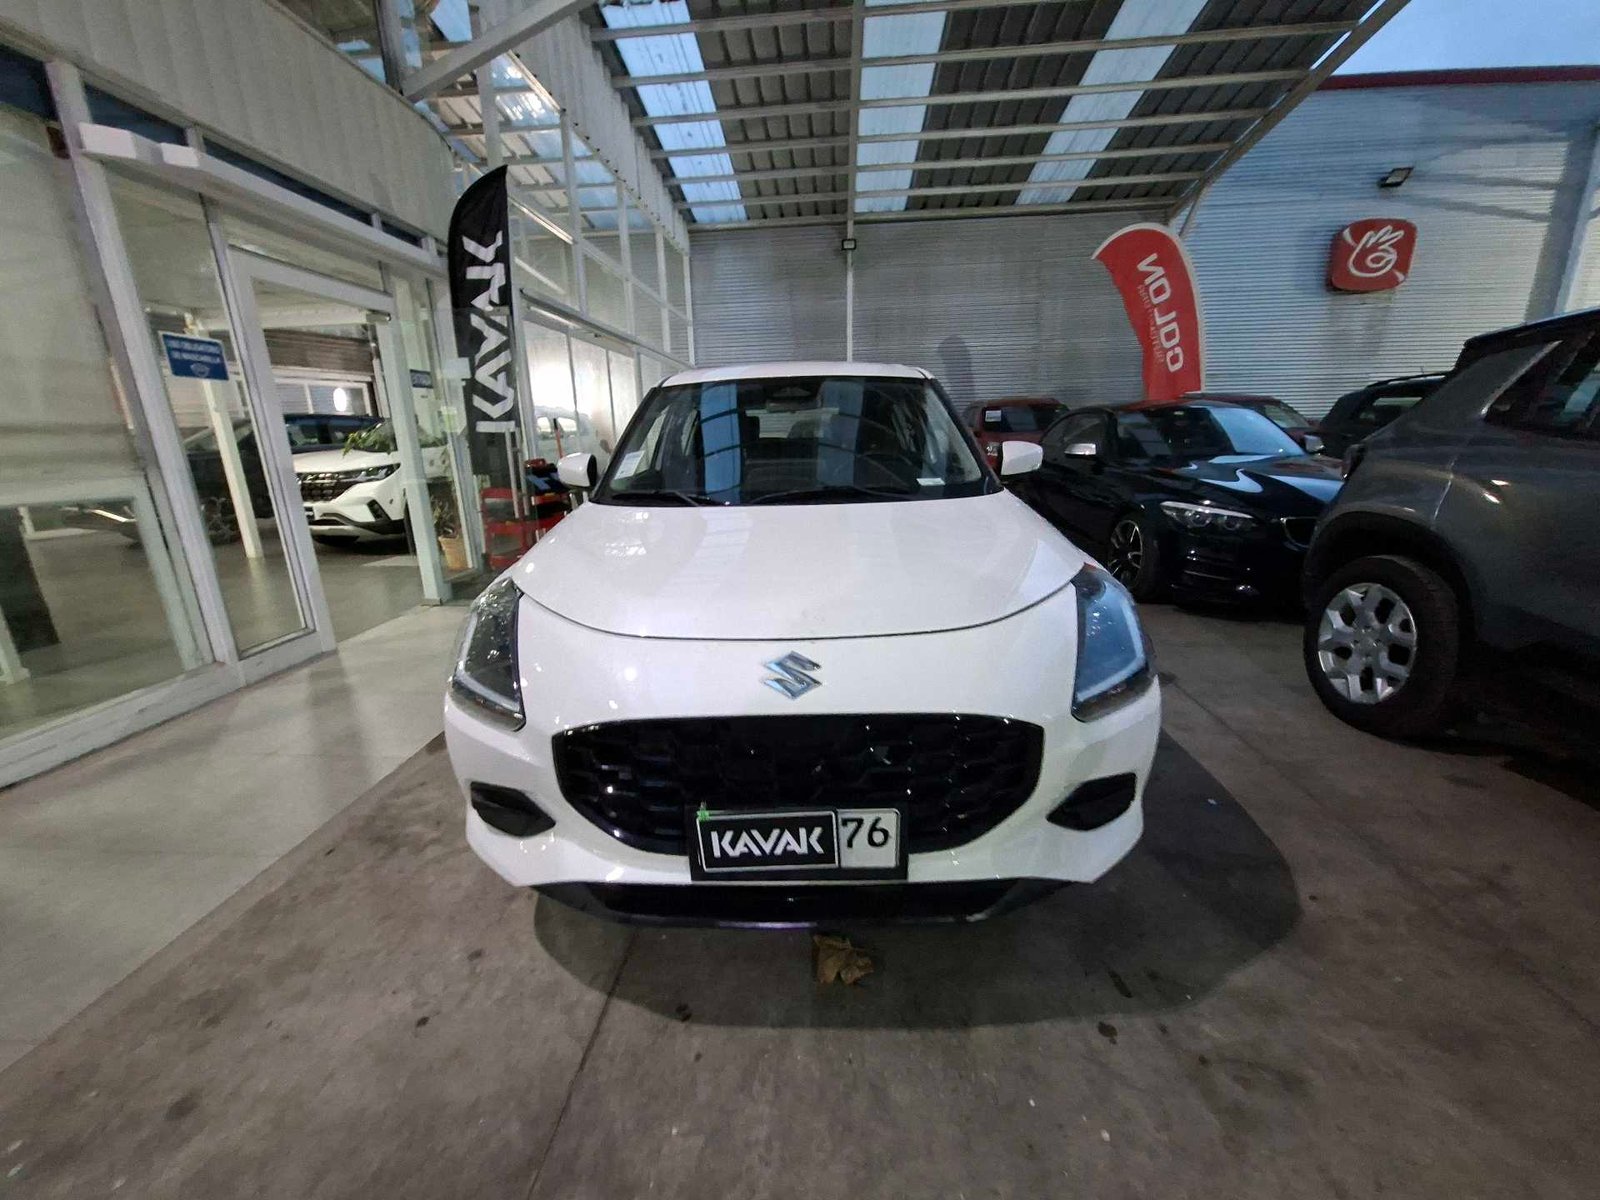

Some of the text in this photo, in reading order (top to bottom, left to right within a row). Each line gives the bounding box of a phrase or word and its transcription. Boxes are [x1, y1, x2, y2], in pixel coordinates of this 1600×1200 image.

[462, 230, 515, 433] KAVAK
[710, 816, 891, 858] KAVAK 76
